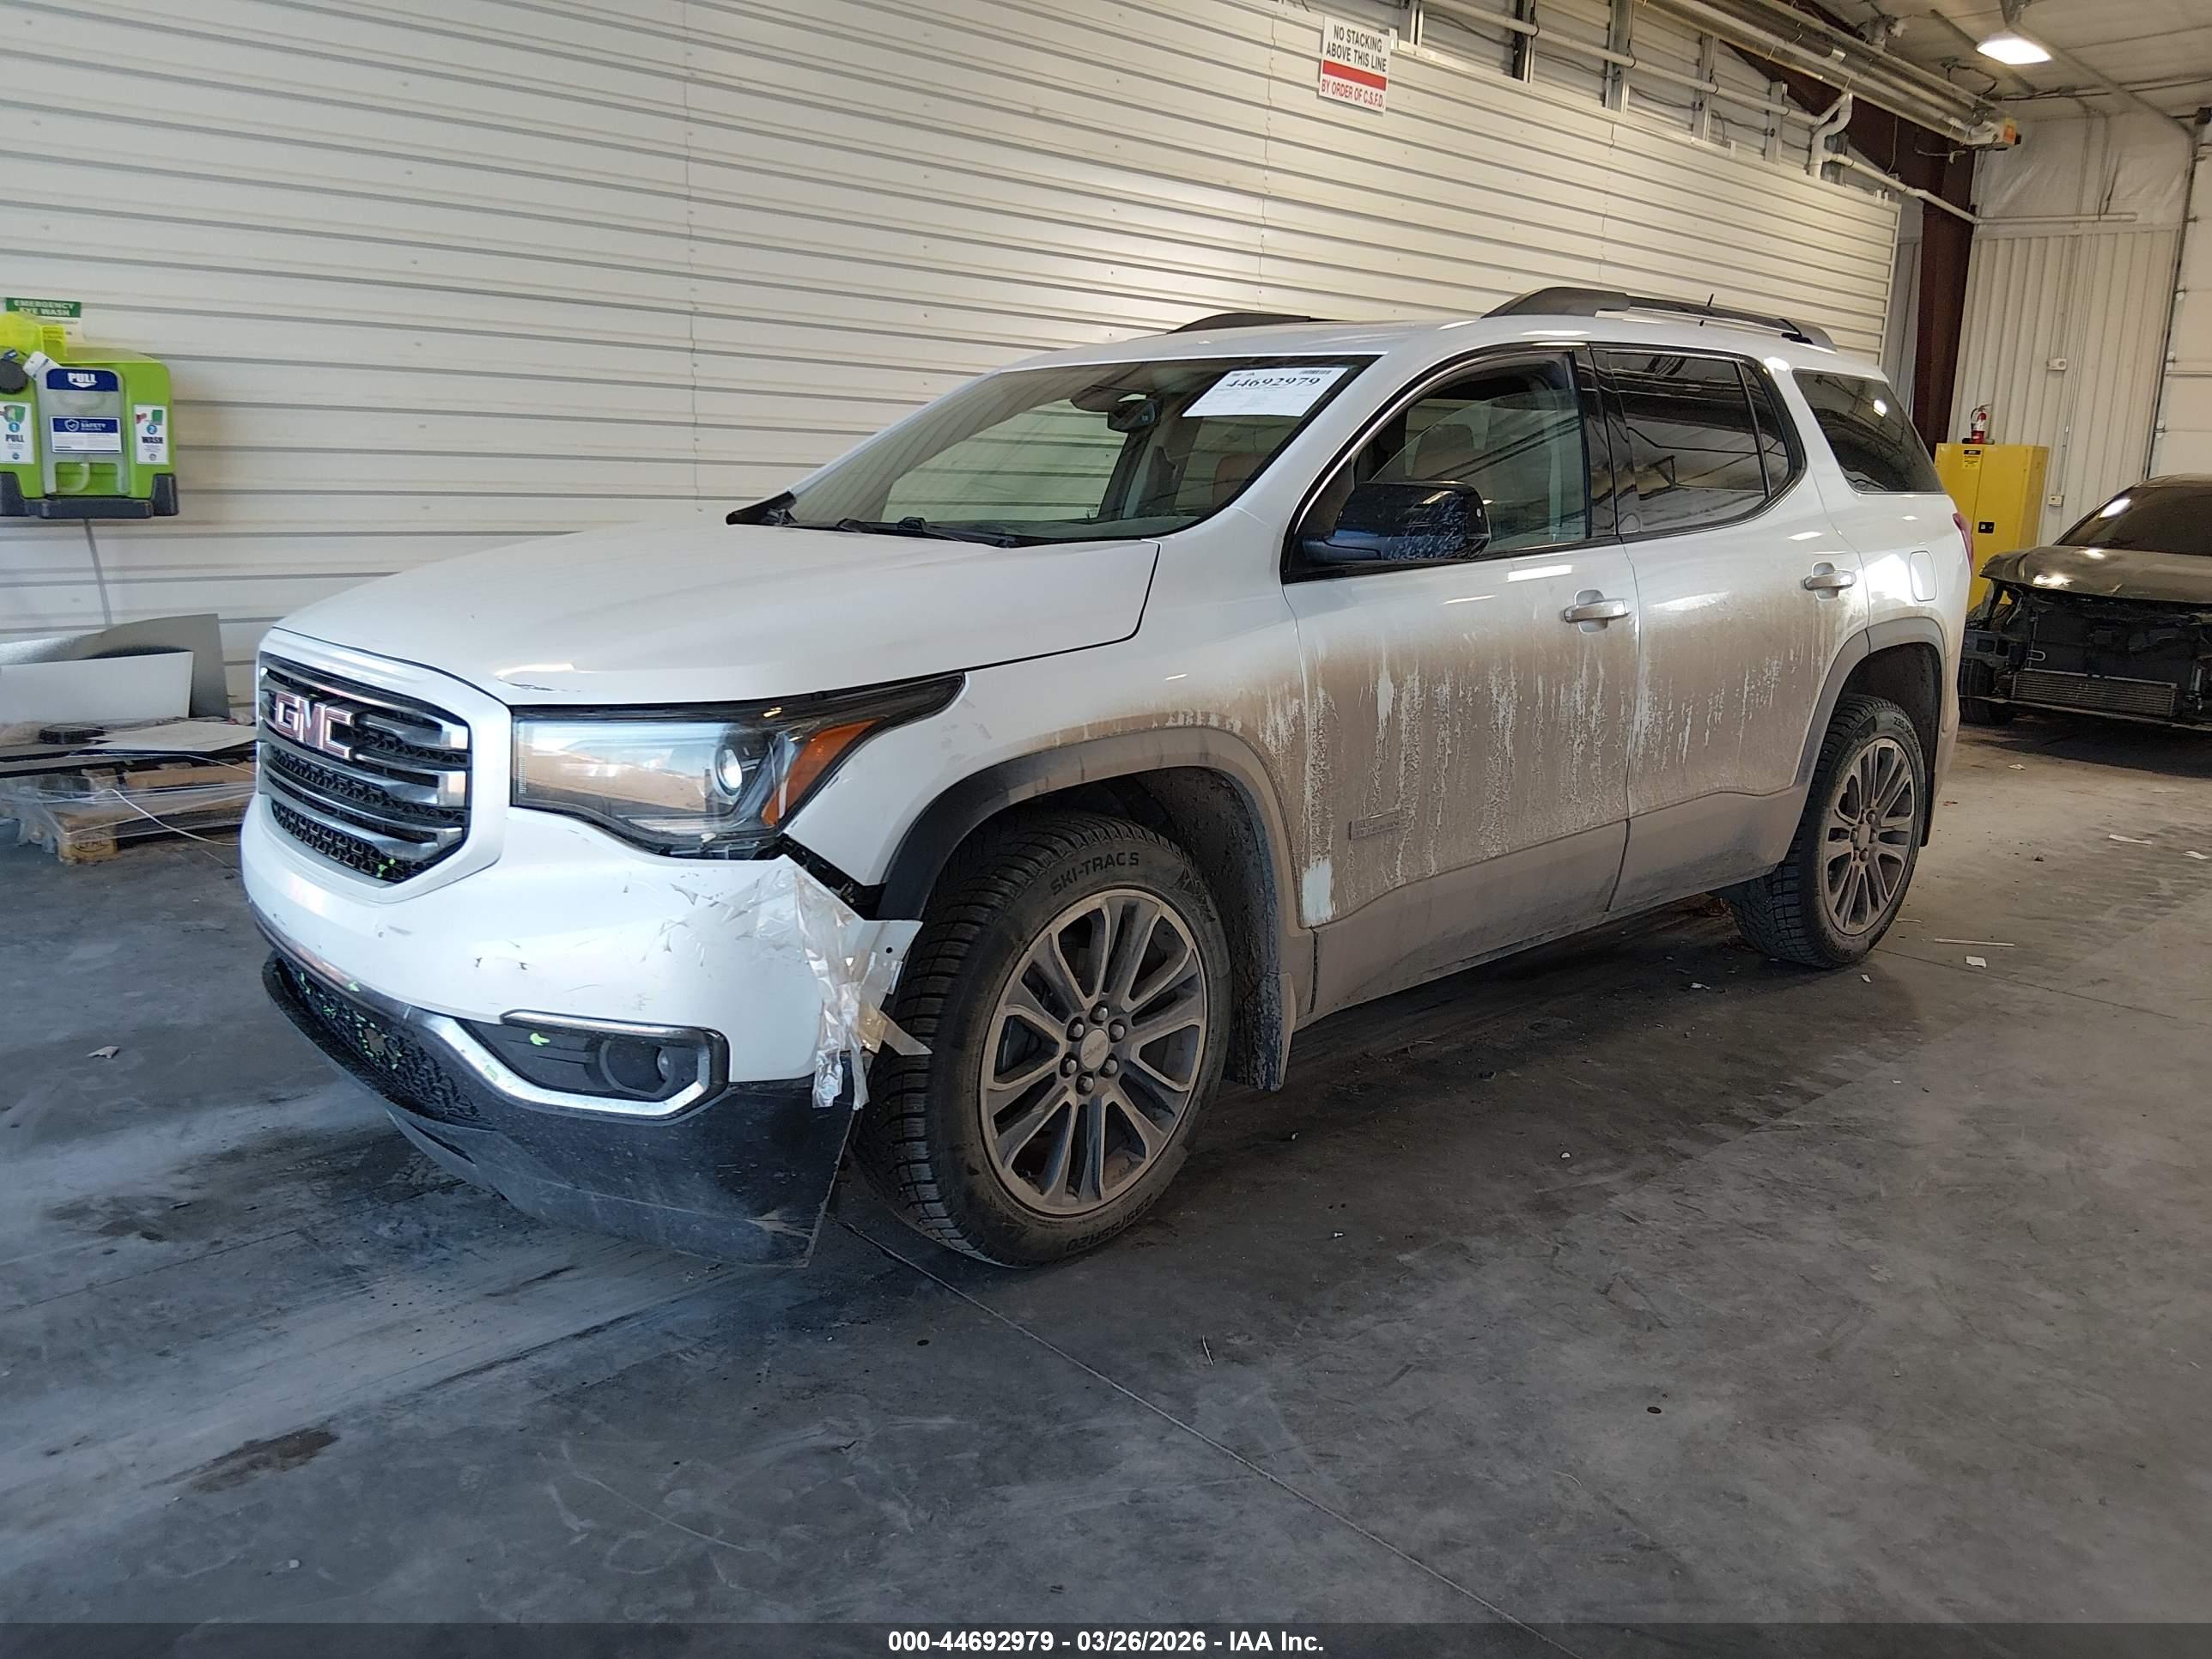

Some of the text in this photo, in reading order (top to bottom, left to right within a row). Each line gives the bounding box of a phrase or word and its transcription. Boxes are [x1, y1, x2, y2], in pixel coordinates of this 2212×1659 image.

[1334, 24, 1382, 52] NO STACKING
[1326, 41, 1387, 72] ABOVE THIS LINE
[1322, 79, 1330, 93] BY
[1332, 82, 1352, 100] ORDER
[1354, 88, 1363, 101] OF
[14, 300, 75, 309] EMERGENCY
[68, 373, 97, 383] PULL
[1226, 377, 1321, 387] 44692979
[5, 434, 25, 442] PULL
[275, 691, 354, 761] GMC
[1049, 852, 1139, 895] SKI-TRACS
